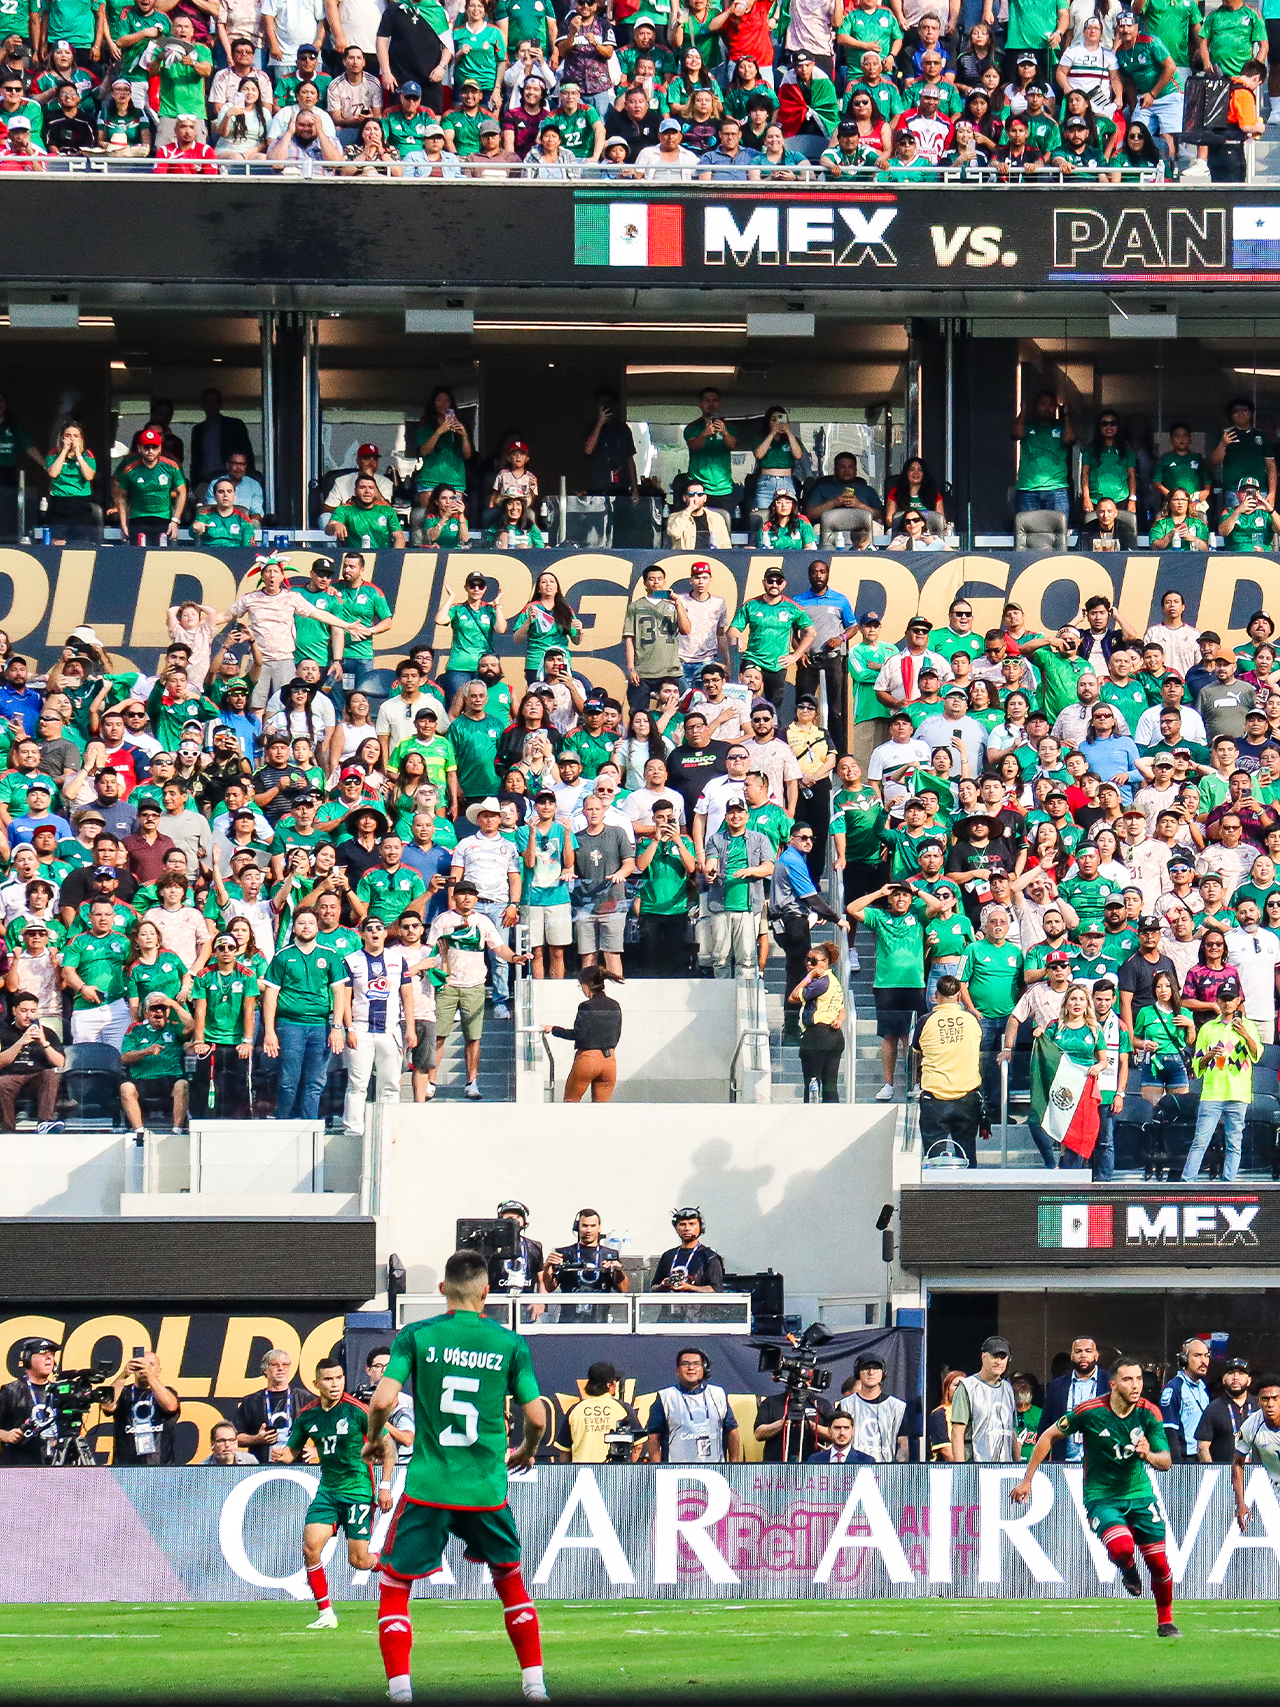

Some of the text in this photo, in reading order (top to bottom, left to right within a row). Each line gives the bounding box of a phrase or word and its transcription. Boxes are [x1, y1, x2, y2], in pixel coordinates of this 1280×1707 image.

[1082, 56, 1098, 66] 22
[564, 133, 583, 146] 22
[704, 206, 898, 267] MEX
[1052, 208, 1226, 268] PAN
[639, 616, 676, 645] 34
[682, 755, 717, 765] MEXICO
[938, 1016, 964, 1028] CSC
[940, 1027, 964, 1037] EVENT
[940, 1035, 964, 1045] STAFF
[1127, 1205, 1261, 1247] MEX
[426, 1345, 504, 1370] J. VÁSQUEZ
[438, 1375, 481, 1447] 5
[584, 1406, 612, 1417] CSC
[585, 1417, 611, 1425] EVENT
[585, 1424, 611, 1432] STAFF
[321, 1435, 338, 1455] 17
[347, 1503, 371, 1526] 17
[218, 1467, 743, 1594] QAR
